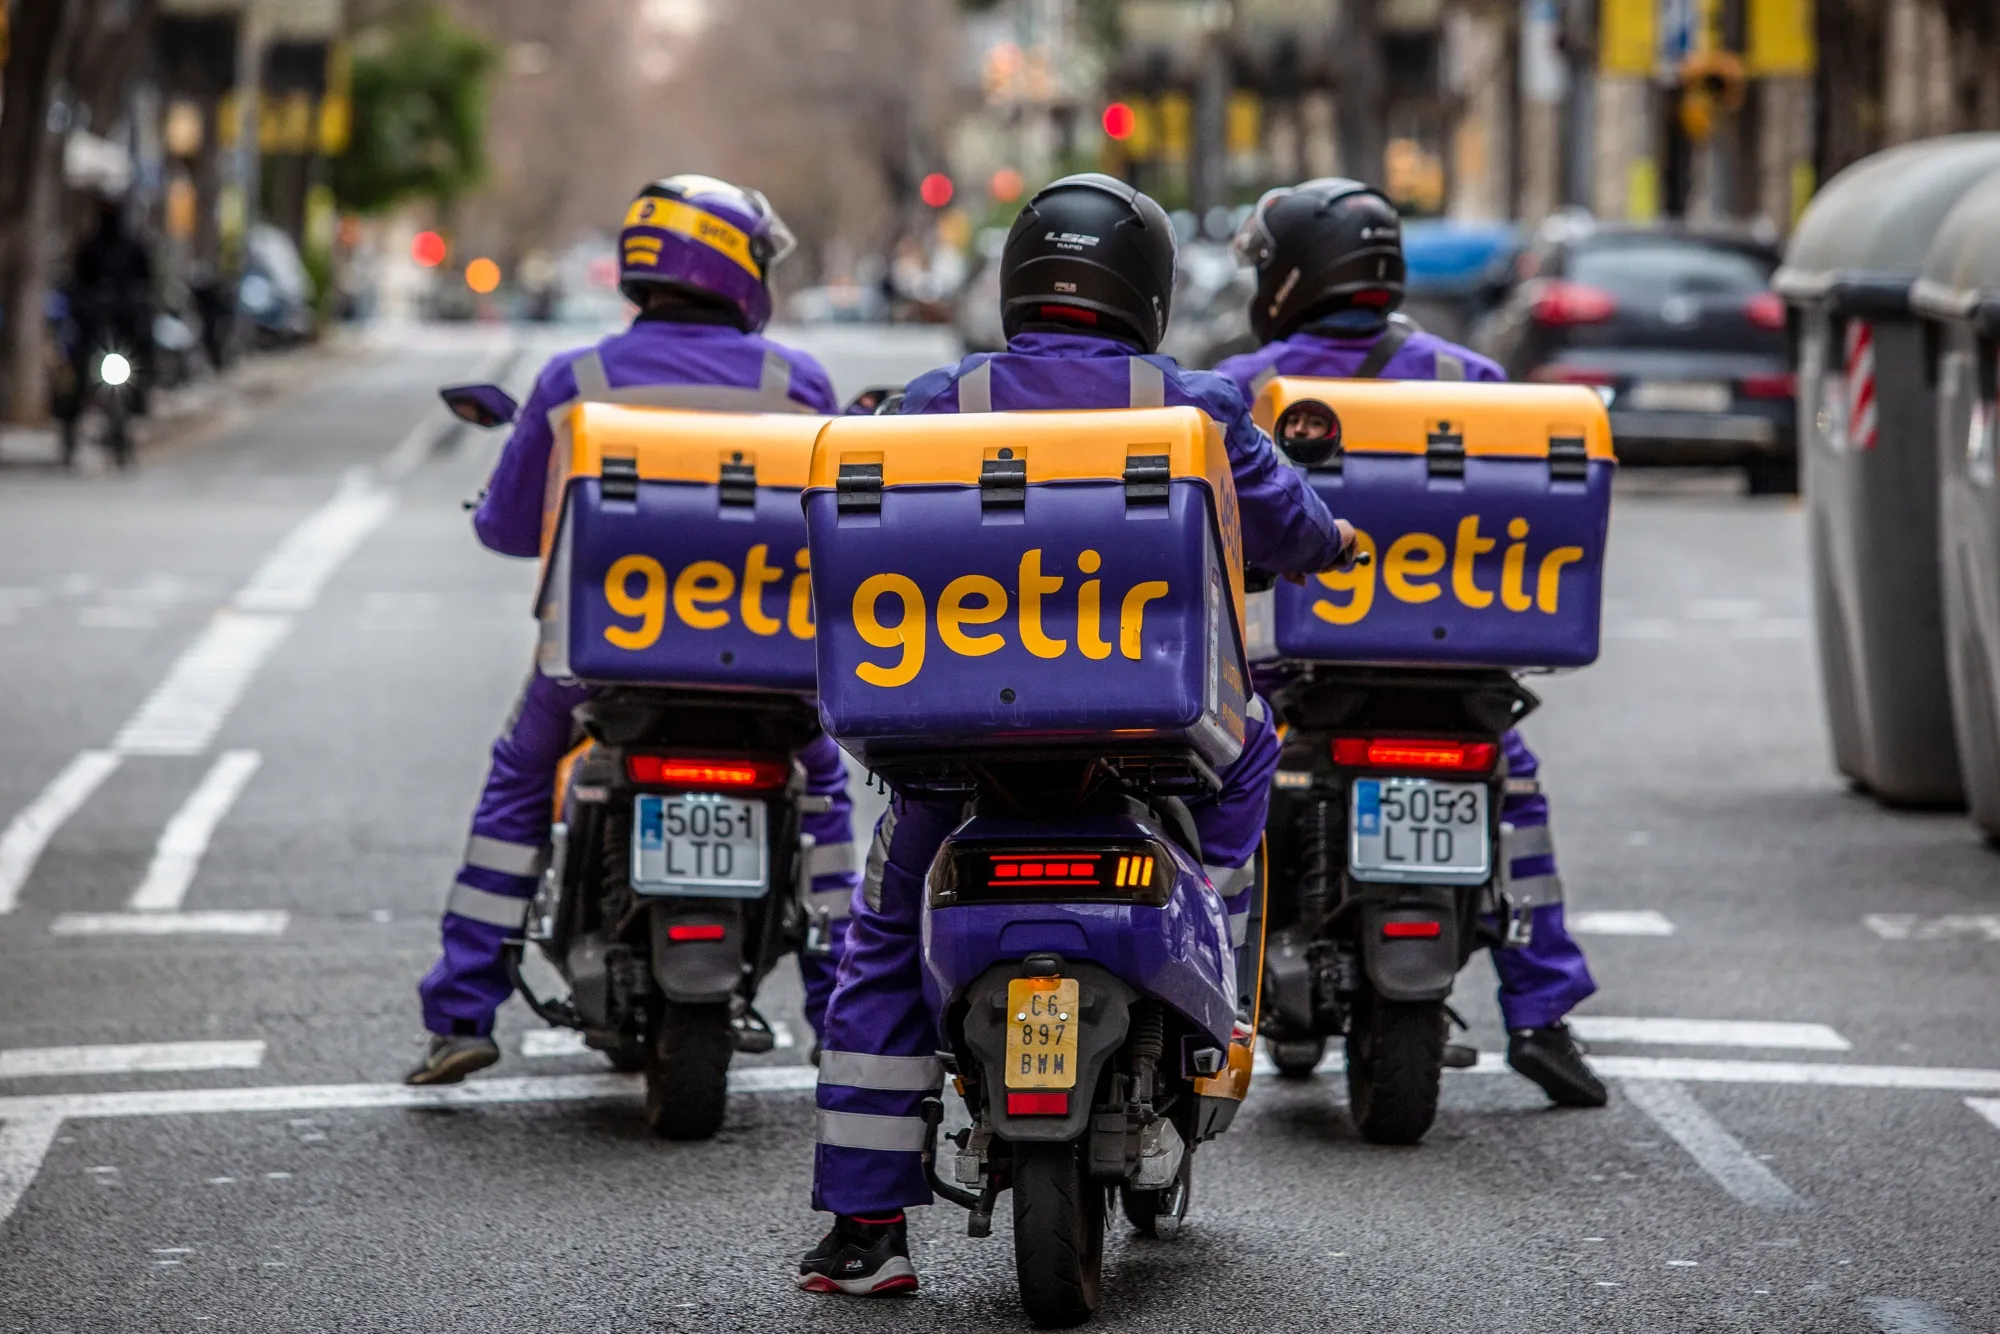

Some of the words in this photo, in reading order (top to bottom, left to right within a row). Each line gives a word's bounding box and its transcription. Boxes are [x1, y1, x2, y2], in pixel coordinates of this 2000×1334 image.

[1044, 231, 1100, 246] LS2
[1056, 242, 1083, 251] RAPID
[1312, 514, 1584, 625] getir
[603, 543, 816, 650] geti
[852, 548, 1169, 687] getir
[666, 803, 752, 838] 5051
[1385, 787, 1477, 825] 5053
[666, 840, 733, 876] LTD
[1385, 826, 1453, 863] LTD
[1031, 994, 1058, 1016] C6
[1022, 1024, 1065, 1046] 897
[1021, 1053, 1064, 1075] BWM
[845, 1259, 863, 1269] FILA
